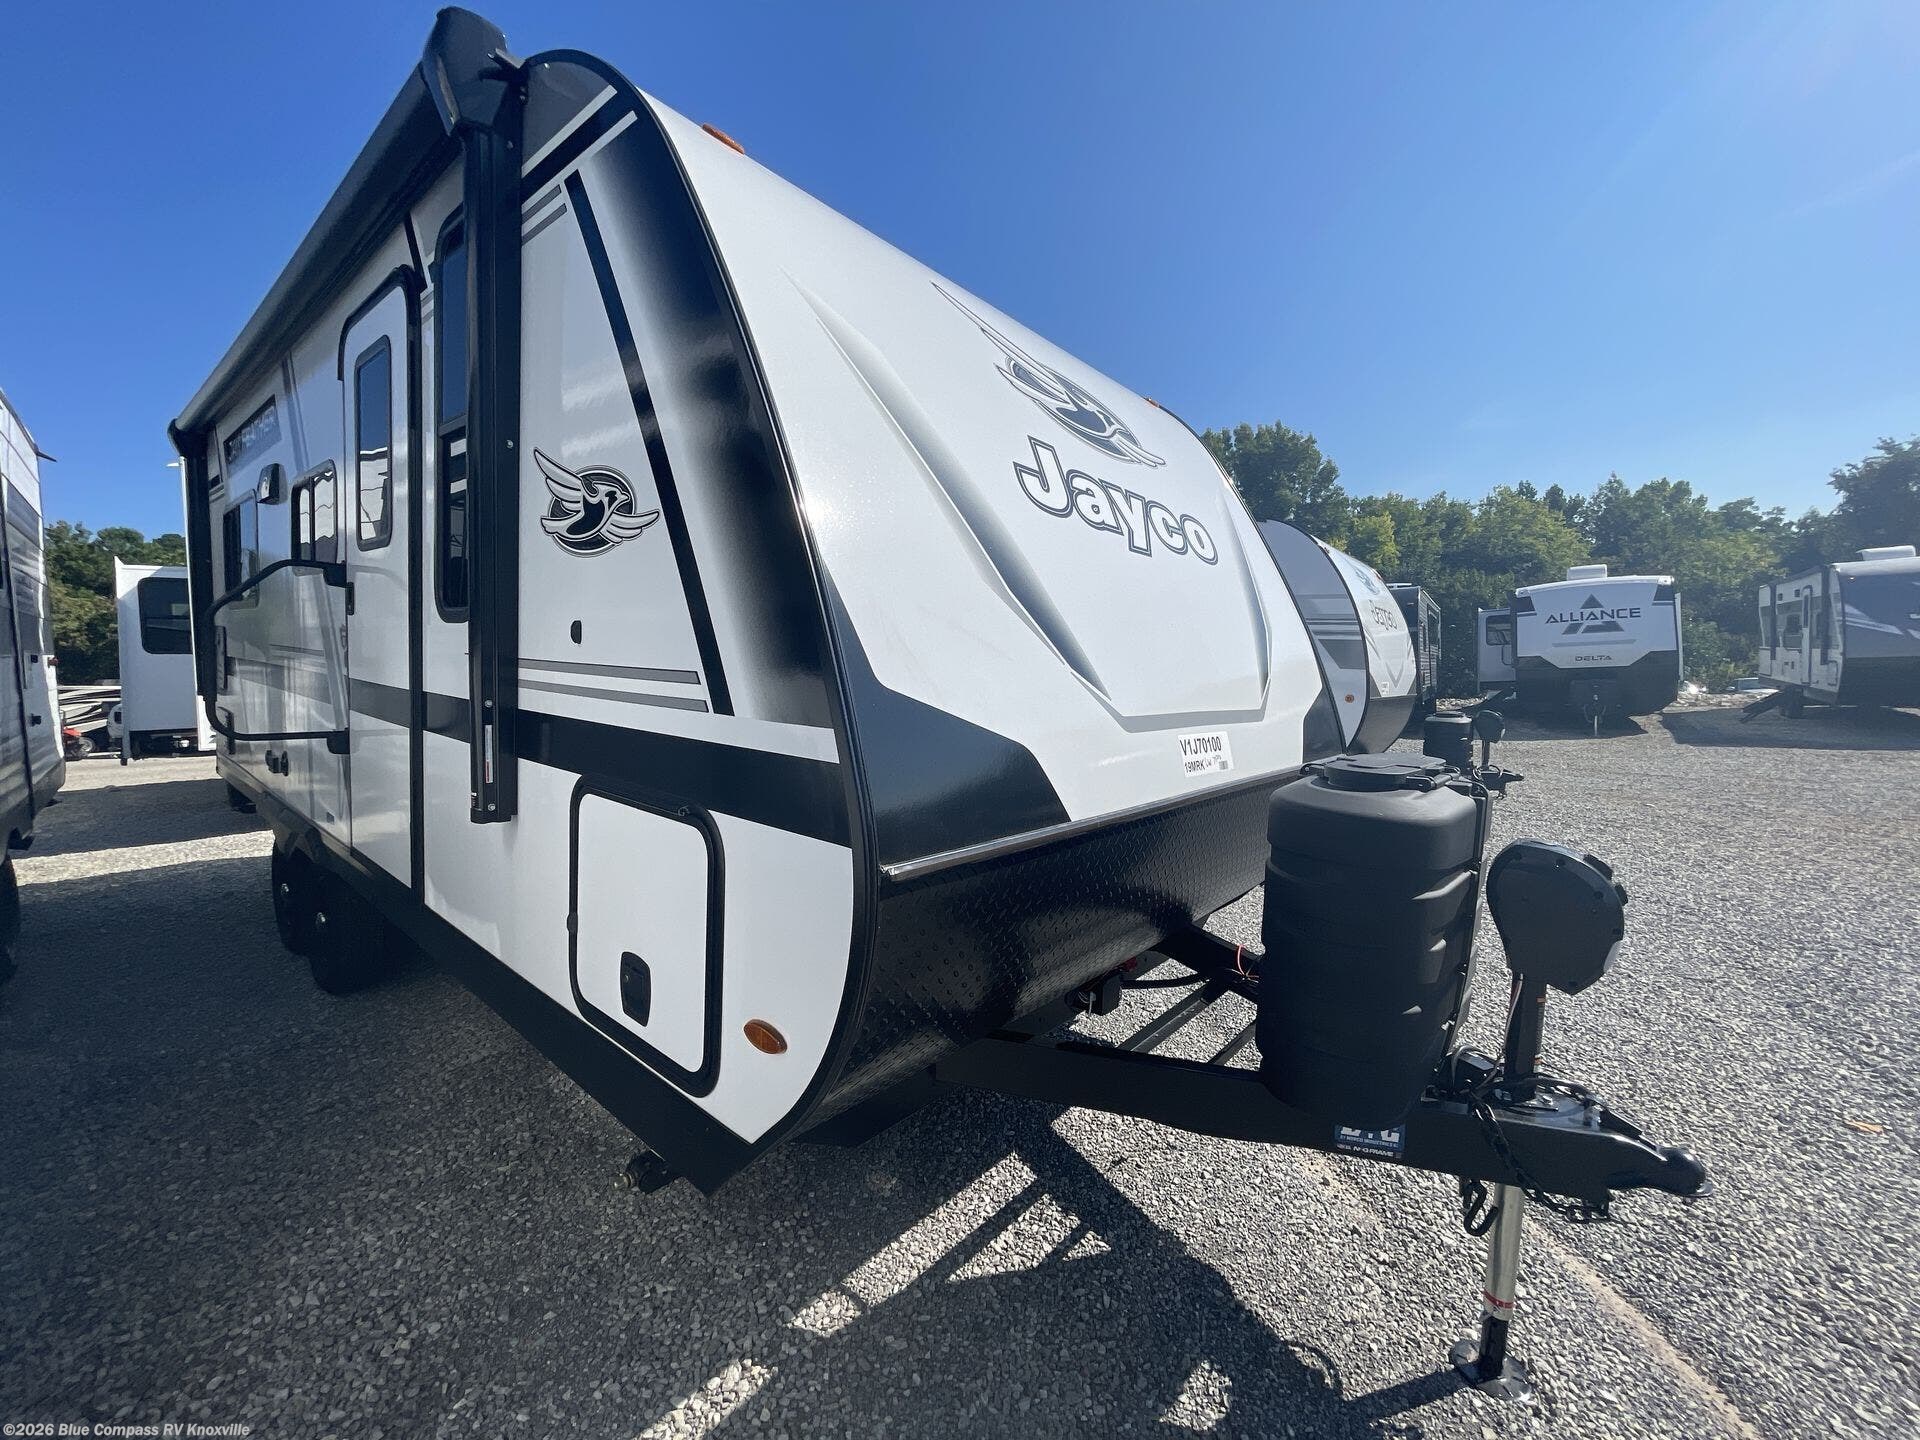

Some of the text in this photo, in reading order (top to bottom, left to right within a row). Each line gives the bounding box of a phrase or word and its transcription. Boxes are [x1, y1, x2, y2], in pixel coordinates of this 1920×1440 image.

[1012, 434, 1219, 565] Jayco
[1545, 607, 1641, 624] ALLIANCE
[1179, 736, 1222, 756] V1J70100
